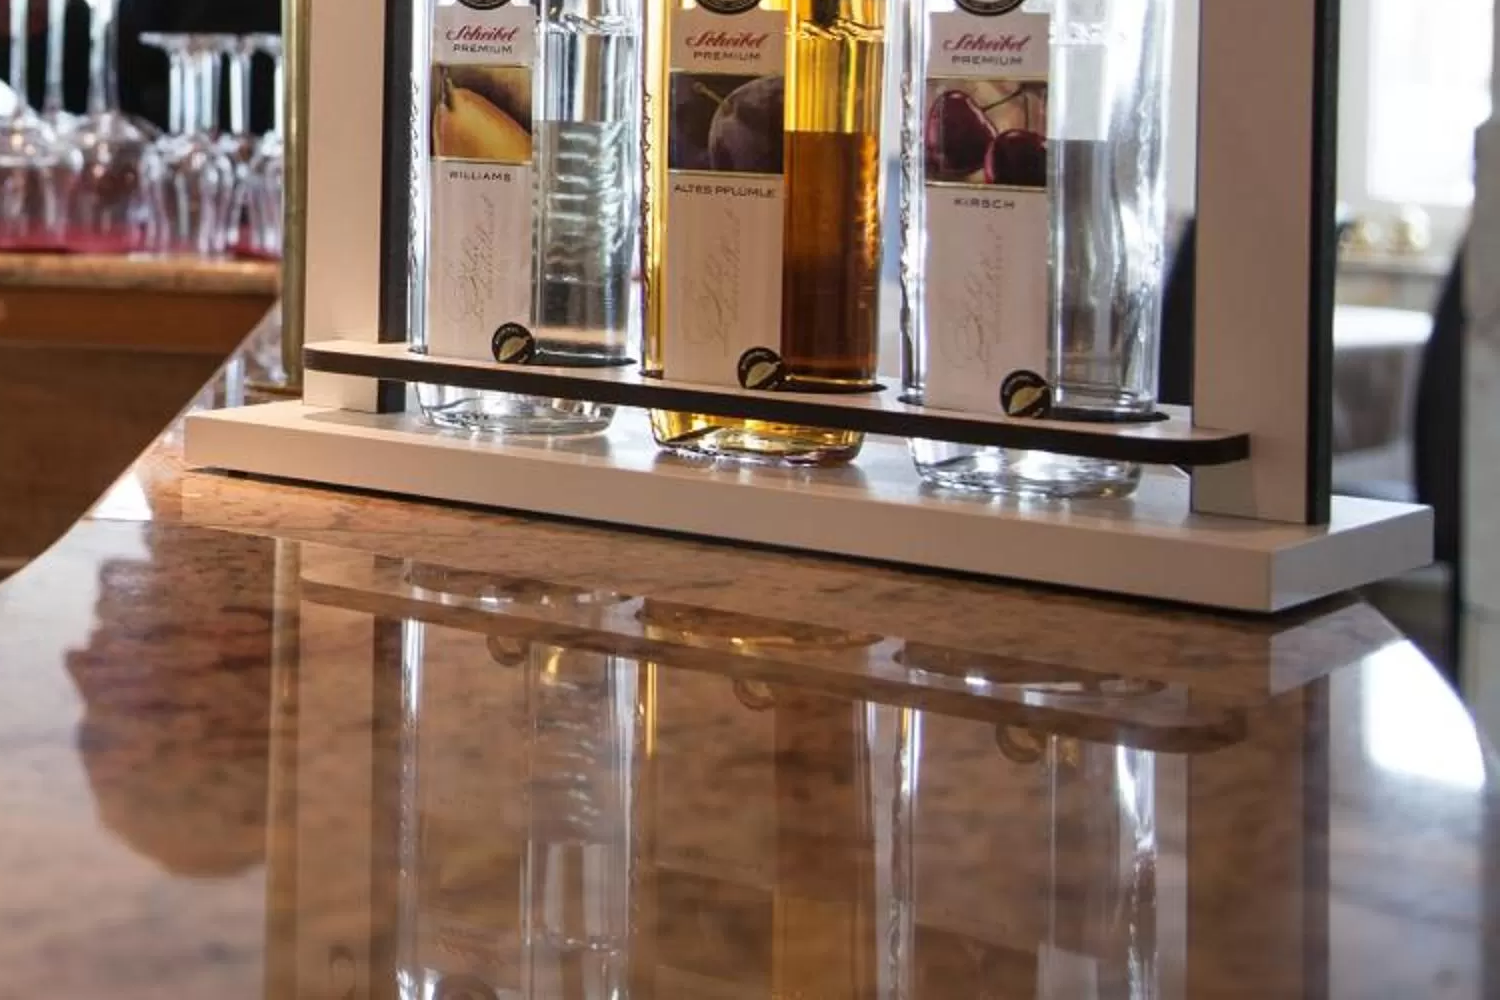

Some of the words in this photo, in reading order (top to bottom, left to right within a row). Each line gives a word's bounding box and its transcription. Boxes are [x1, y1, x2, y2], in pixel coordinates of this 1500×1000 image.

[446, 24, 521, 41] Scheibel
[685, 31, 769, 49] Scheibel
[942, 33, 1032, 52] Scheibel
[452, 43, 513, 55] PREMIUM
[692, 51, 762, 61] PREMIUM
[951, 55, 1024, 66] PREMIUM
[448, 171, 512, 183] WILLIAMS
[953, 198, 1016, 210] KIRSCH
